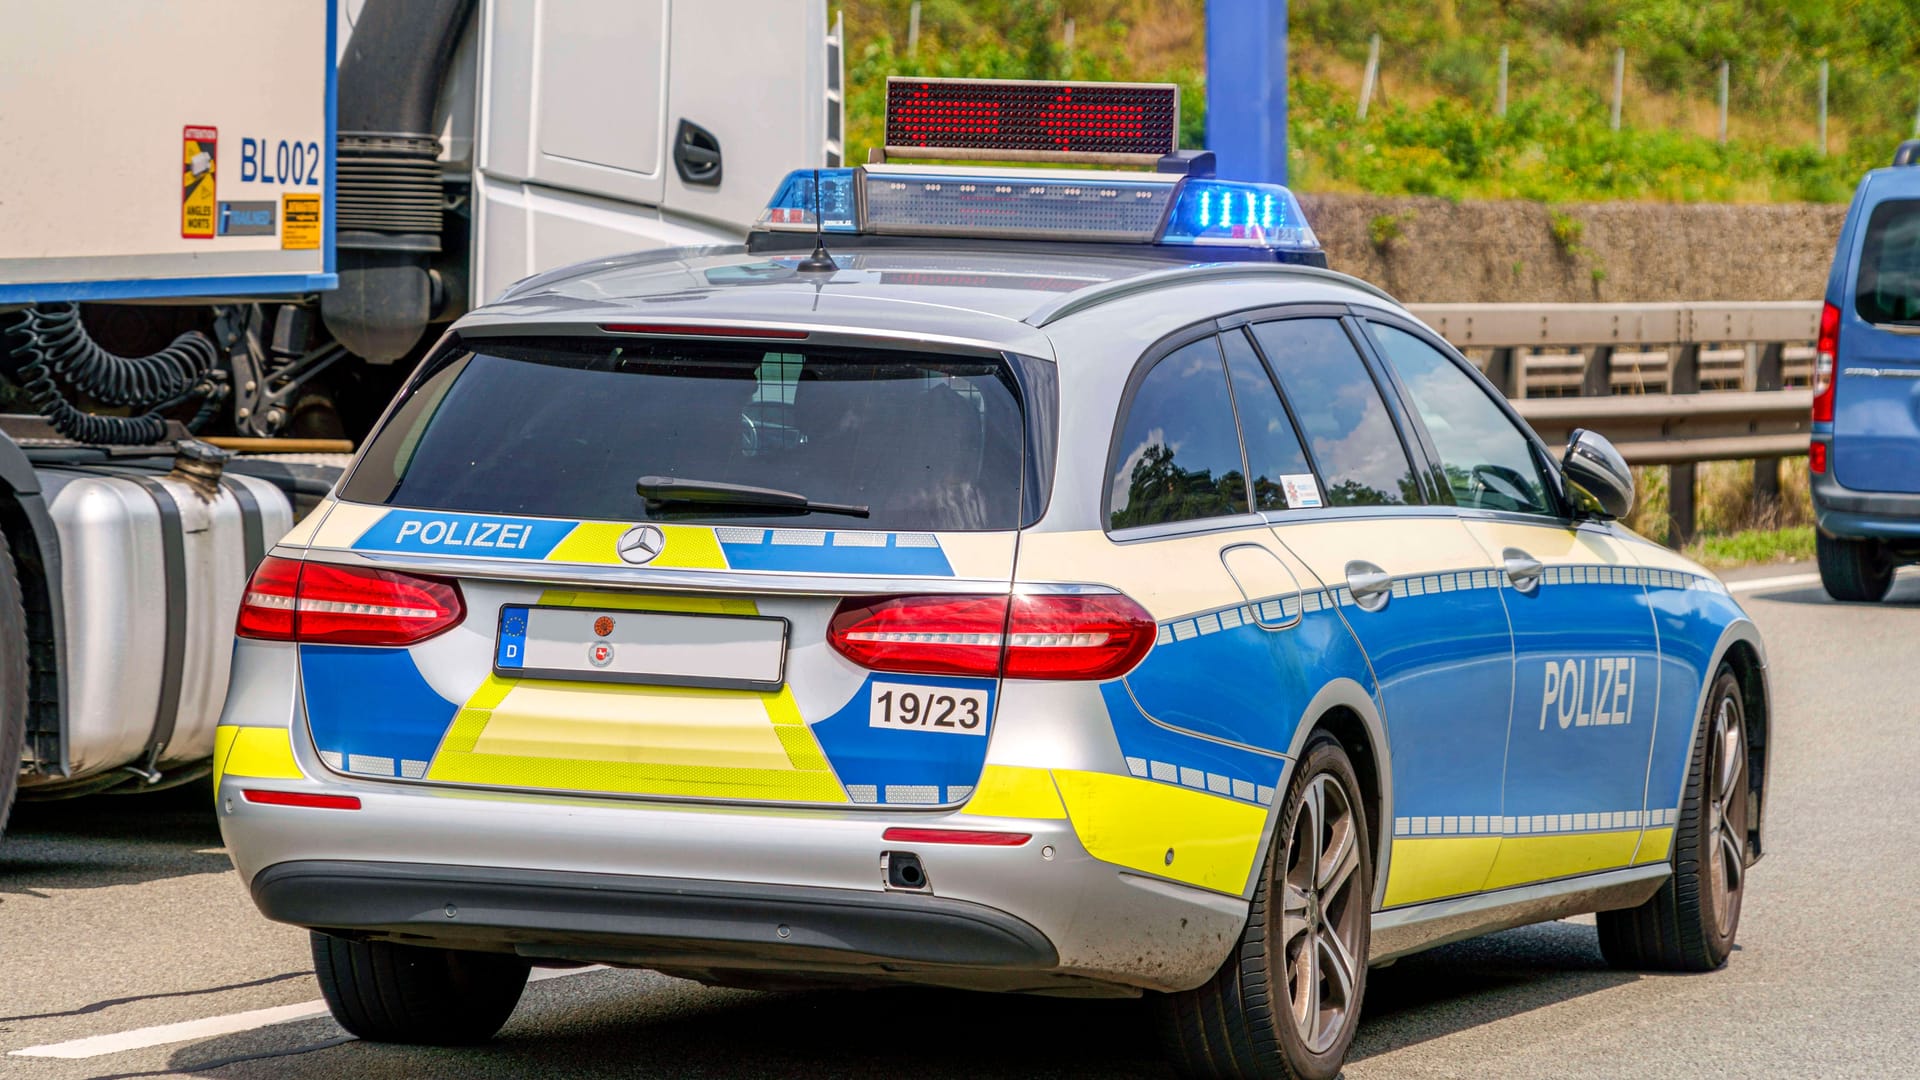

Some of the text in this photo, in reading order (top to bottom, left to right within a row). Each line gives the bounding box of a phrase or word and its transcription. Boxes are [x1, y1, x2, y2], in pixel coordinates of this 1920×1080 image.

[241, 137, 319, 185] BL002
[187, 205, 211, 216] ANGLES
[188, 218, 210, 229] MORTS
[396, 521, 532, 549] POLIZEI
[507, 645, 517, 658] D
[1539, 656, 1636, 731] POLIZEI
[877, 690, 980, 729] 19/23
